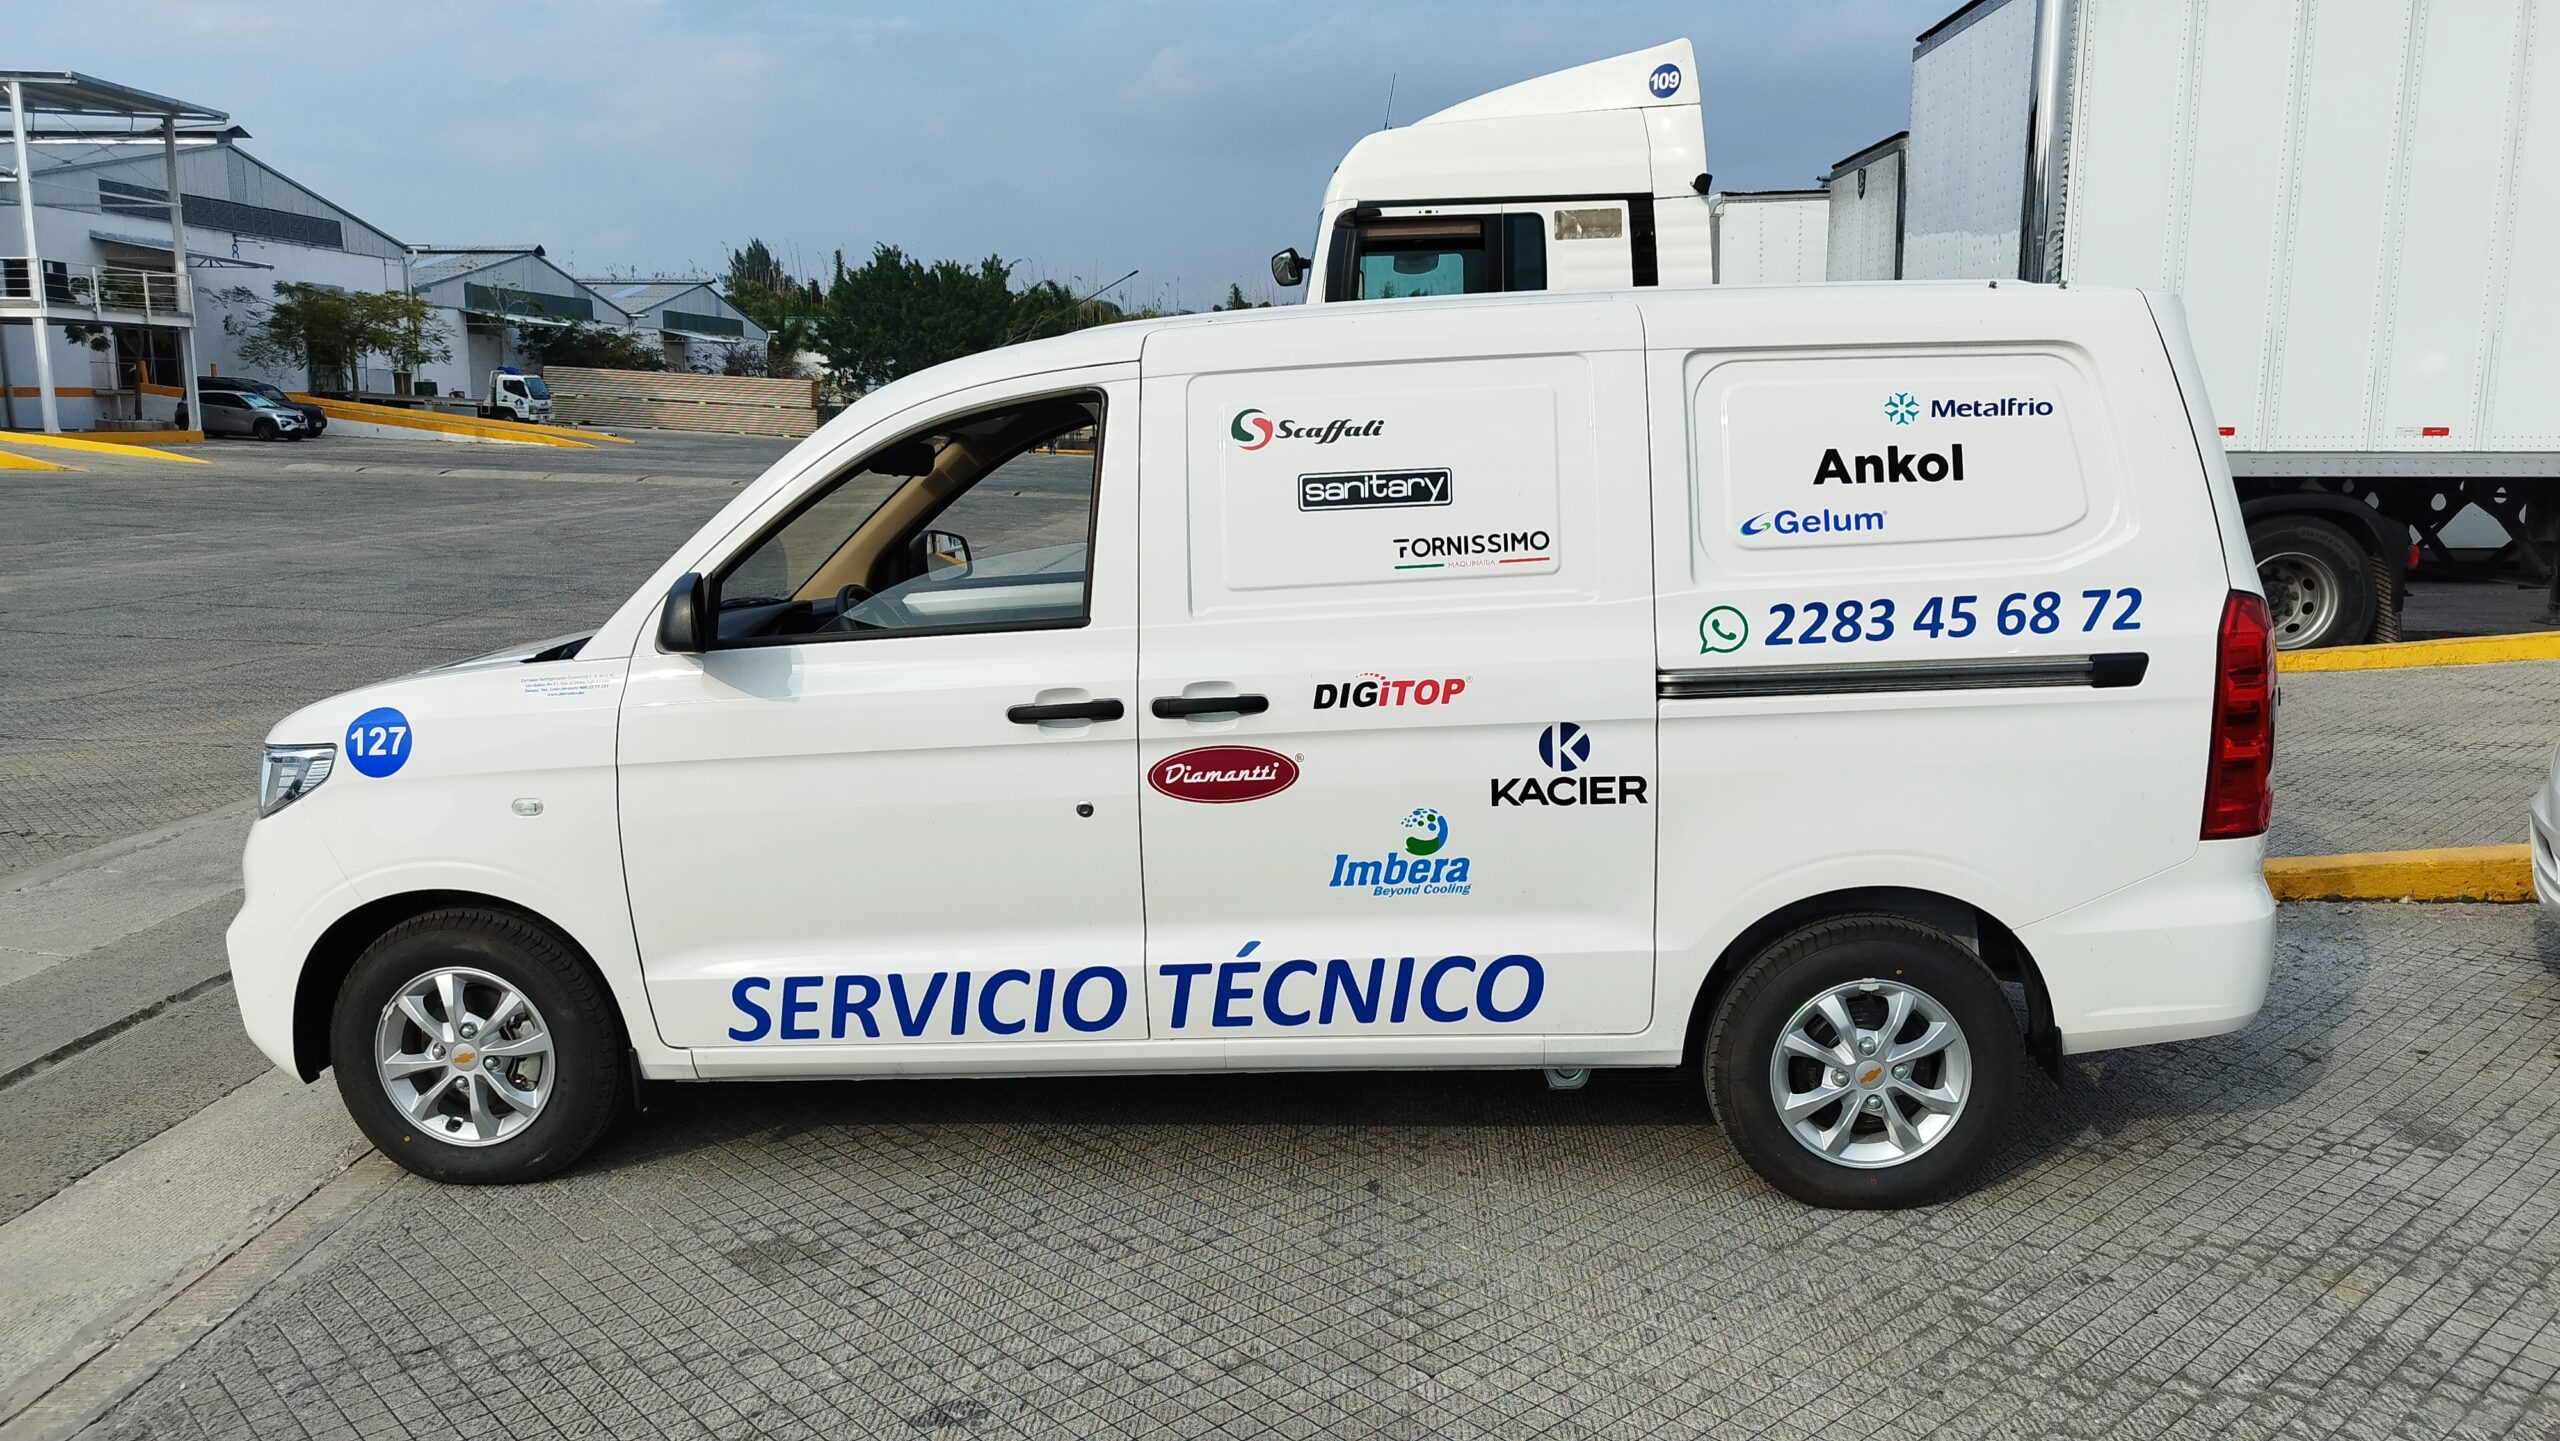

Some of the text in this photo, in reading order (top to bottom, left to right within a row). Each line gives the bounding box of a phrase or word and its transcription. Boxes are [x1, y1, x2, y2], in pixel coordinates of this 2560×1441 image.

[1650, 71, 1680, 90] 109
[1931, 397, 2054, 418] Metalfrio
[1275, 418, 1385, 445] Scaffali
[1812, 443, 1964, 485] Ankol
[1304, 474, 1445, 503] sanitary
[1774, 508, 1884, 535] Gelum
[1392, 530, 1551, 559] FORNISSIMO
[1448, 559, 1496, 568] MAQUINARIA
[1764, 587, 2143, 646] 2283 45 68 72
[350, 725, 408, 757] 127
[1164, 761, 1280, 785] Diamantti
[1490, 775, 1649, 807] KACIER
[1328, 851, 1471, 888] Imbera
[1372, 882, 1472, 898] Beyond Cooling
[728, 940, 1545, 1042] SERVICIO TÉCNICO
